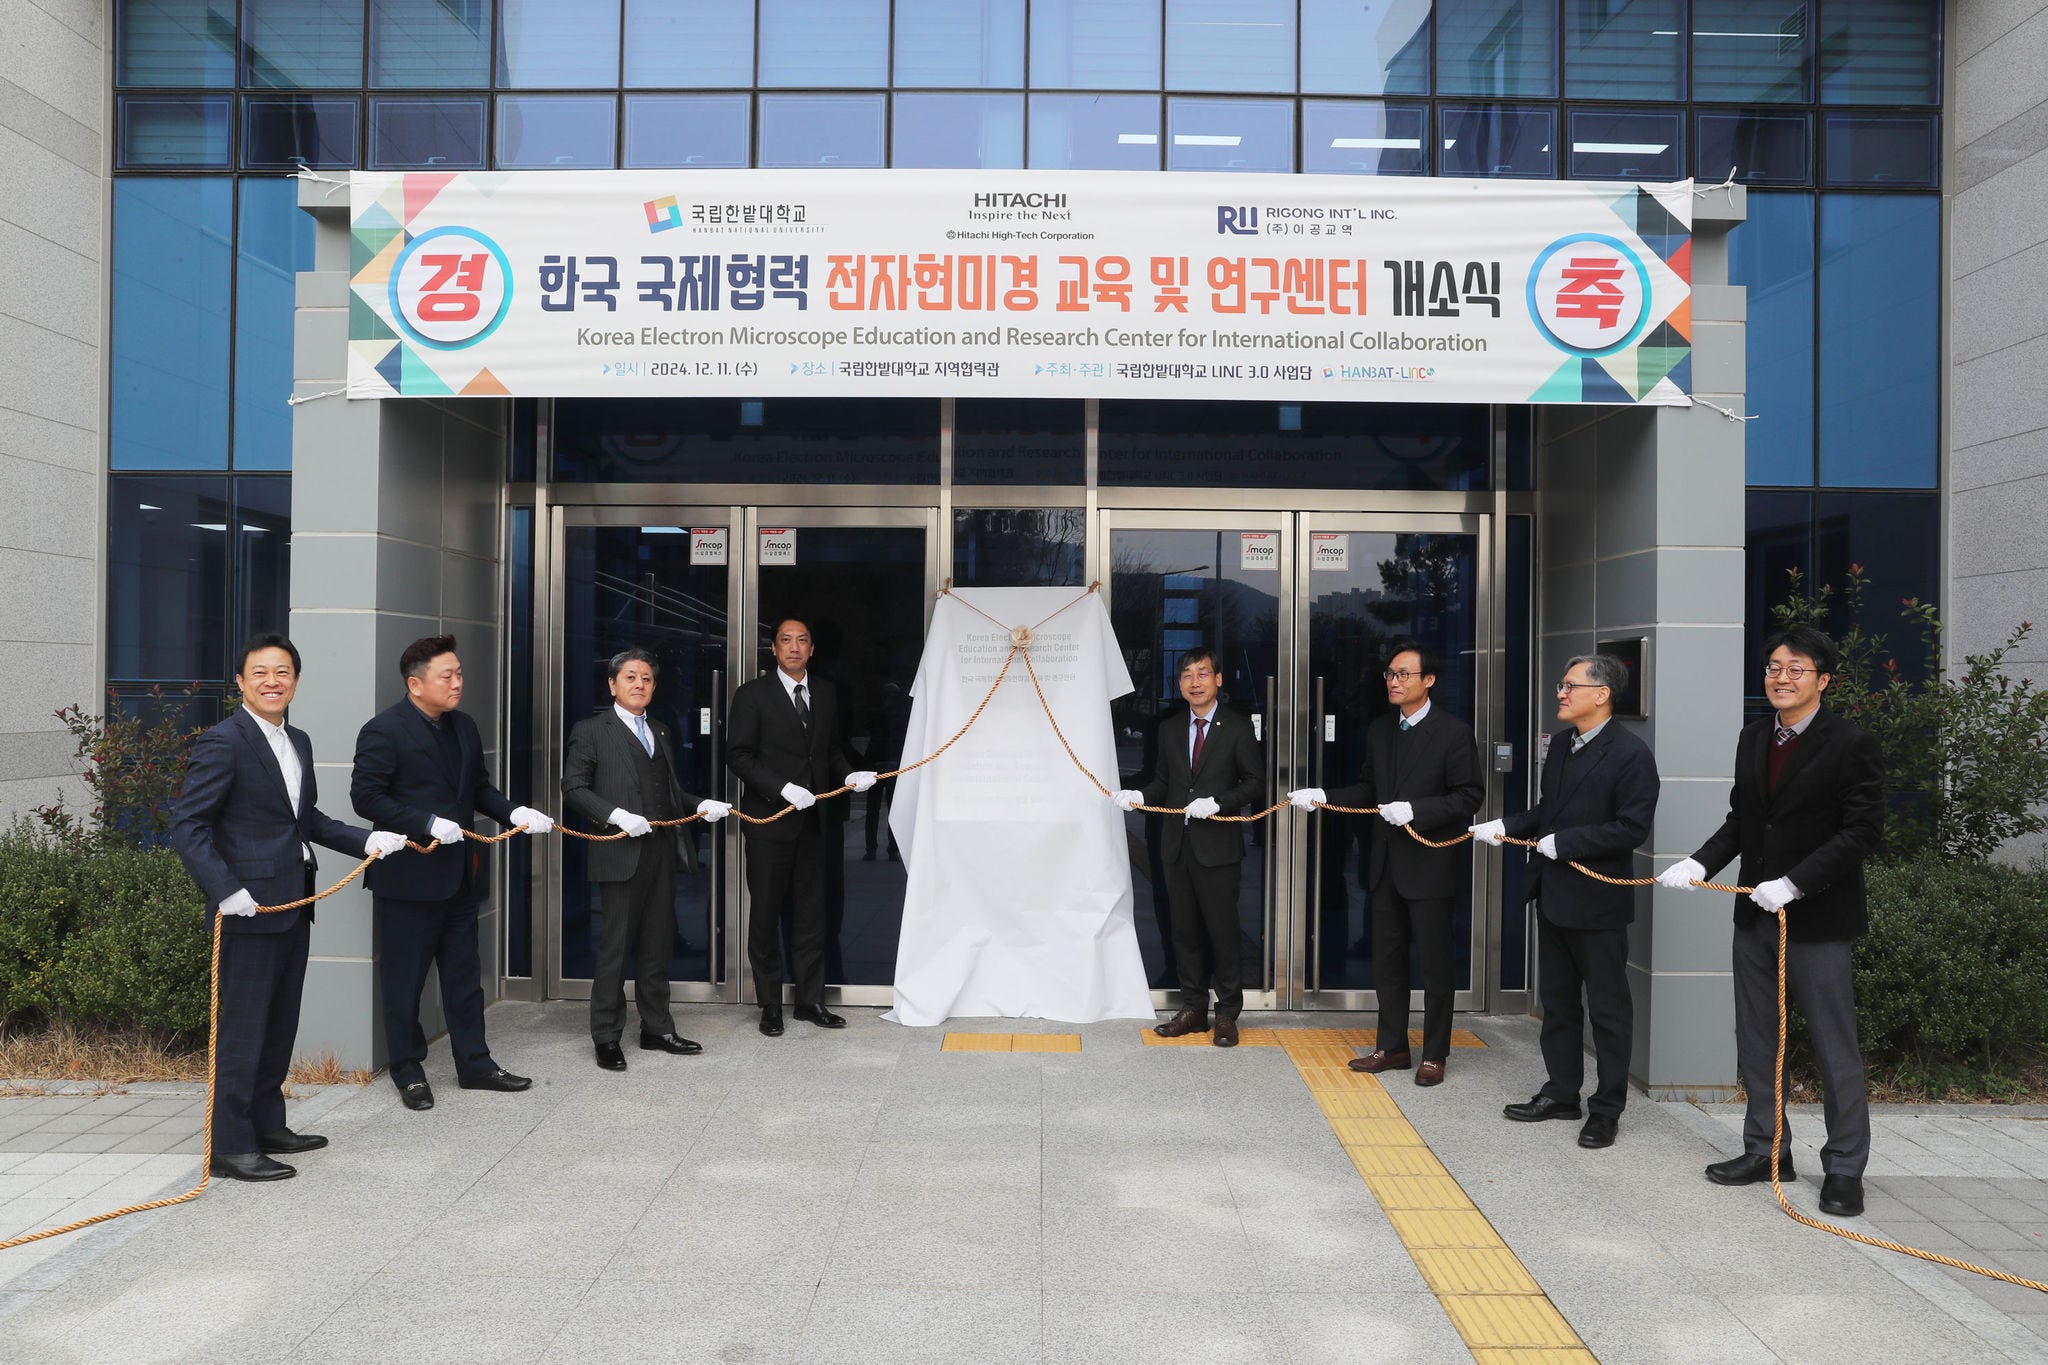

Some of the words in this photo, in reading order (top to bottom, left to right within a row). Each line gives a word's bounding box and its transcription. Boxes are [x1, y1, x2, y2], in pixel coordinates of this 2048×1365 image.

[974, 193, 1067, 208] HITACHI
[692, 204, 806, 223] 국립한밭대학교
[968, 210, 1013, 222] Inspire
[1017, 211, 1038, 220] the
[1042, 210, 1072, 220] Next
[1266, 208, 1325, 219] RIGONG
[1370, 210, 1399, 220] INC.
[957, 231, 990, 240] Hitachi
[991, 231, 1038, 241] High-Tech
[1040, 232, 1095, 242] Corporation
[417, 253, 489, 322] 경
[539, 254, 620, 312] 한국
[637, 254, 809, 312] 국제협력
[826, 254, 1039, 312] 전자현미경
[1056, 256, 1133, 313] 교육
[1150, 256, 1189, 313] 및
[1207, 256, 1367, 316] 연구센터
[1384, 260, 1501, 318] 개소식
[1556, 258, 1625, 330] 축
[577, 328, 635, 345] Korea
[641, 327, 724, 345] Electron
[730, 327, 848, 349] Microscope
[853, 327, 957, 345] Education
[961, 327, 1001, 345] and
[1007, 327, 1099, 346] Research
[1104, 328, 1171, 347] Center
[1178, 329, 1207, 347] for
[1212, 330, 1345, 349] International
[1350, 332, 1488, 351] Collaboration
[614, 362, 639, 376] 일시
[651, 363, 691, 376] 2024.
[695, 363, 713, 376] 12.
[717, 363, 732, 376] 11.
[735, 362, 758, 376] (수)
[802, 362, 828, 376] 장소
[839, 361, 930, 377] 국립한밭대학교
[934, 361, 1000, 377] 지역협력관
[1116, 363, 1208, 379] 국립한밭대학교
[1211, 365, 1243, 378] LINC
[1248, 365, 1269, 379] 3.0
[1273, 365, 1313, 381] 사업단
[967, 633, 989, 642] Korea
[1033, 632, 1072, 642] icroscope
[958, 644, 997, 653] Education
[1054, 643, 1080, 652] Center
[961, 655, 972, 664] for
